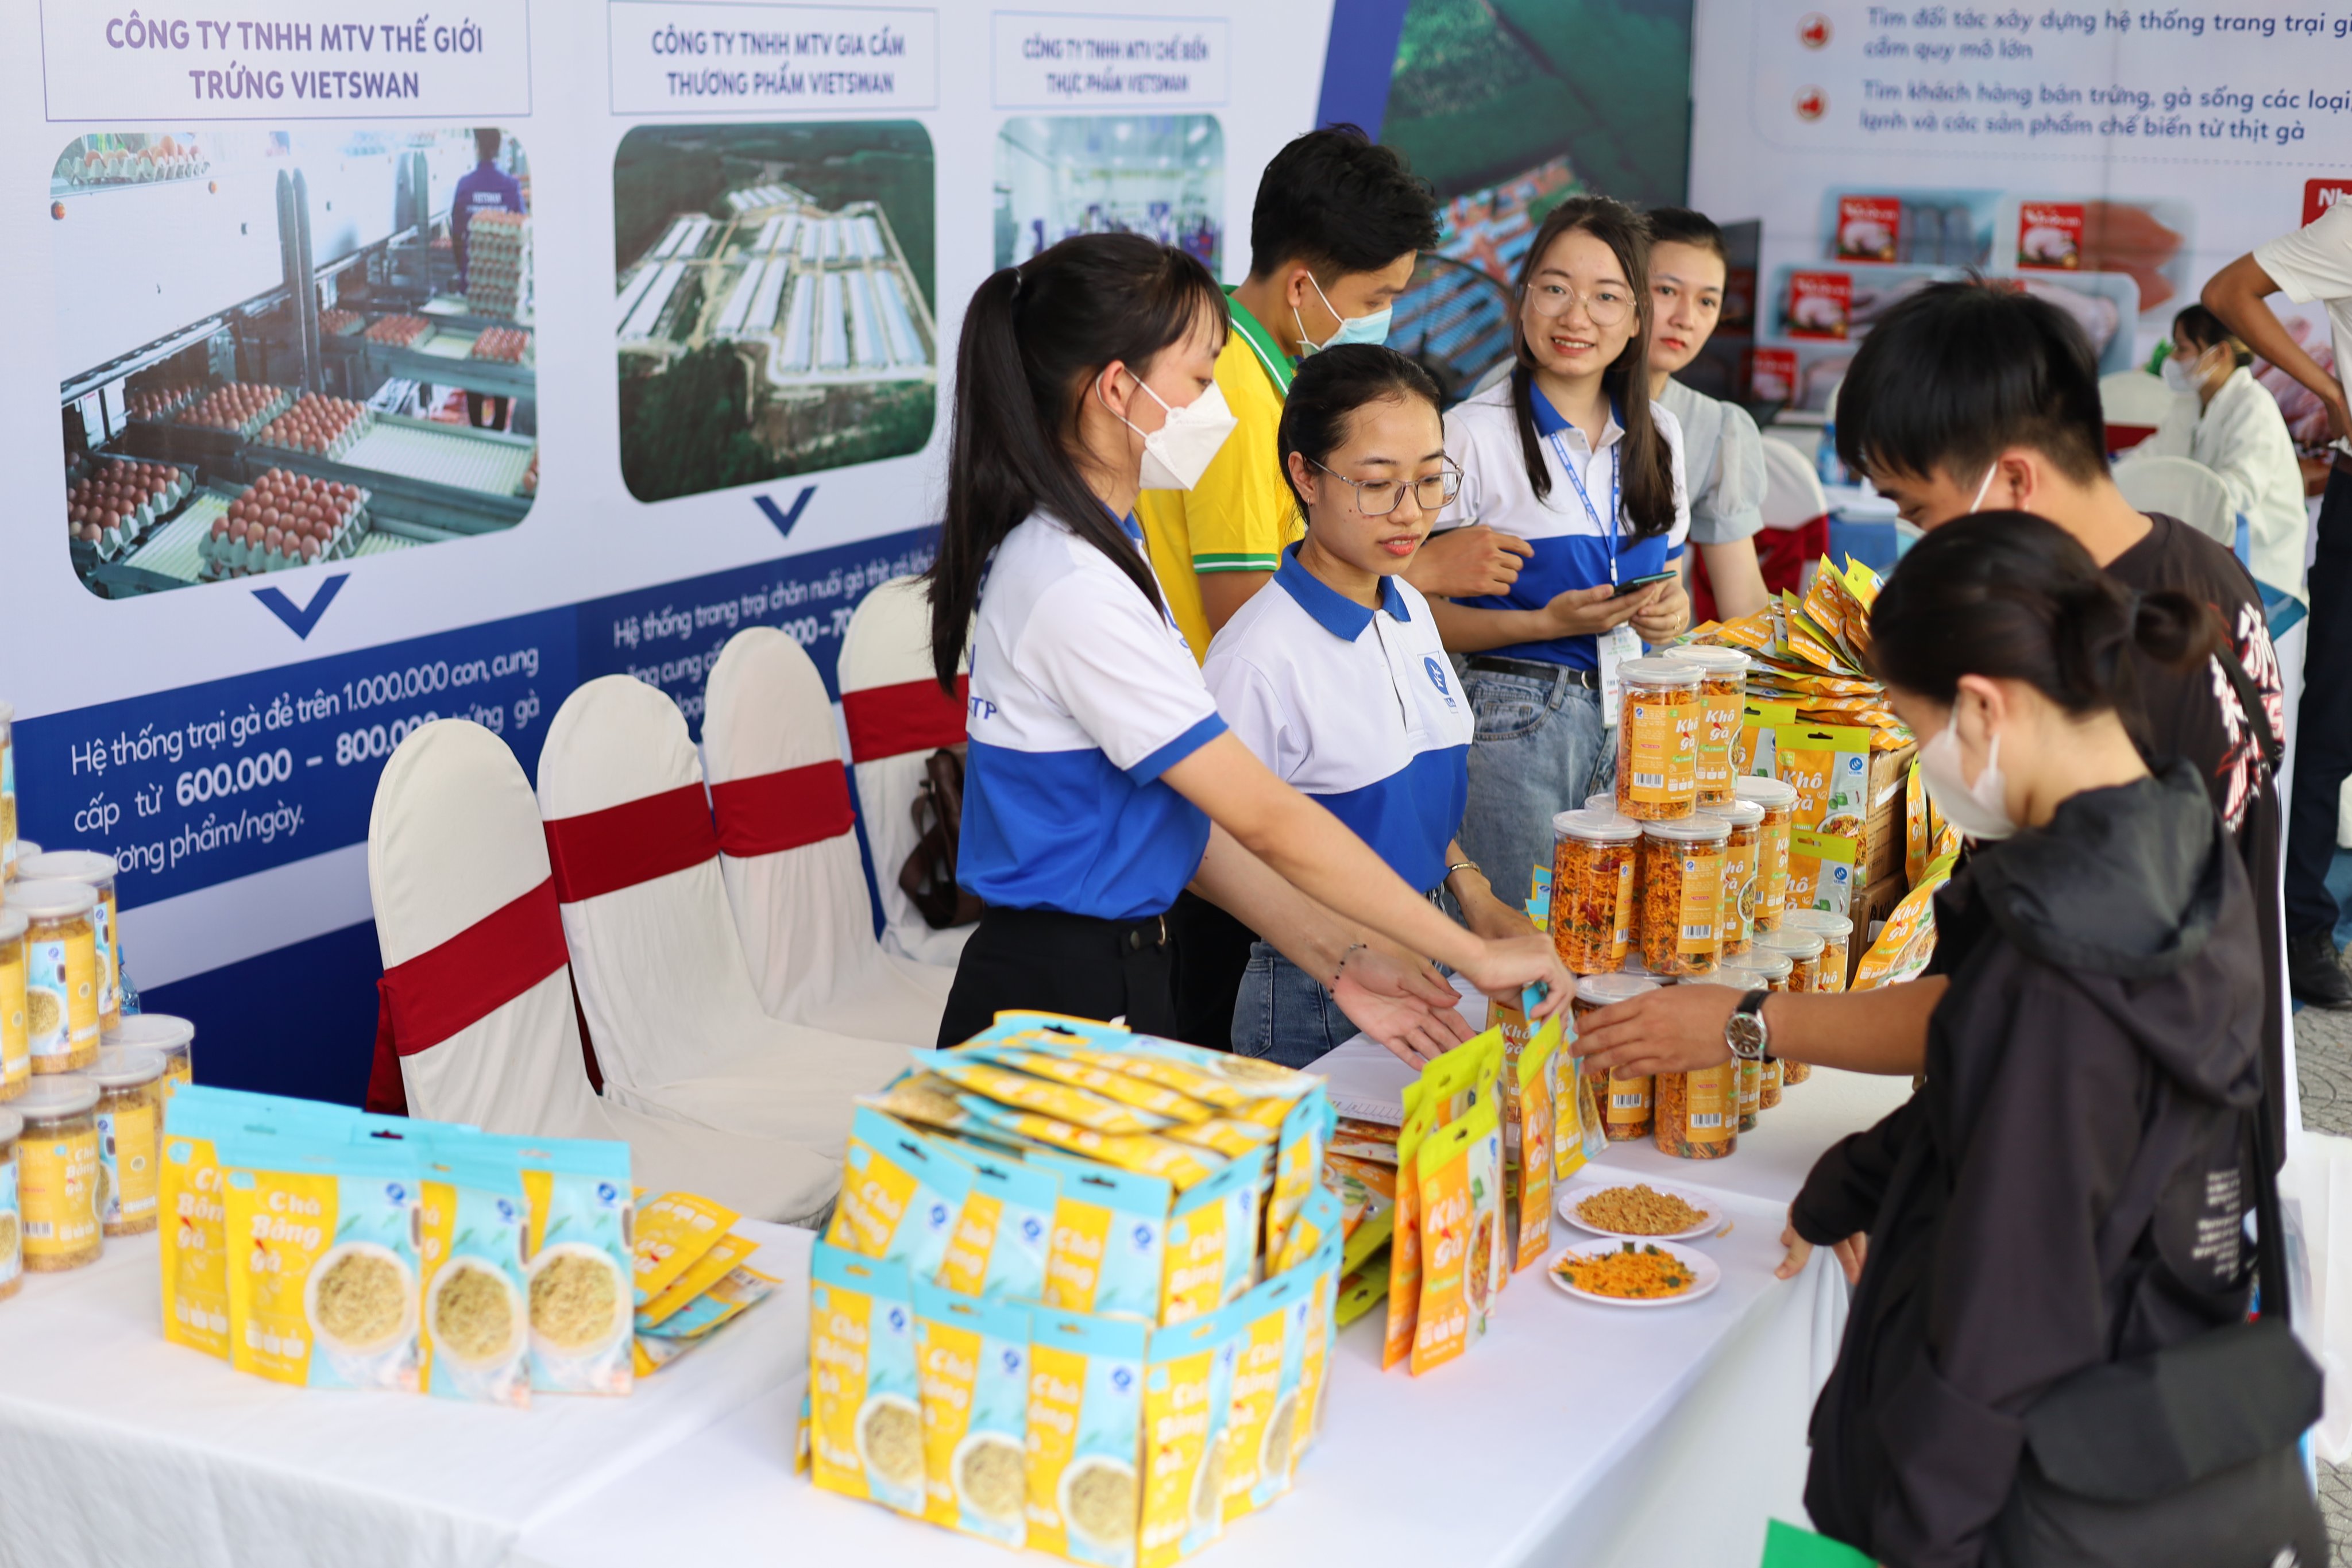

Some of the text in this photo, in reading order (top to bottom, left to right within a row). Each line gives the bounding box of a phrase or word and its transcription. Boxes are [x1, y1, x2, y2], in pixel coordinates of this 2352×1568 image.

[106, 9, 482, 53] CÔNG TY TNHH MTV THẾ GIỚI
[1867, 6, 1906, 28] Tìm
[1913, 5, 1946, 29] đối
[1954, 8, 1987, 29] tác
[1995, 9, 2033, 33] xây
[2040, 8, 2096, 35] dựng
[2104, 10, 2130, 32] hệ
[2139, 9, 2204, 36] thống
[2214, 14, 2276, 37] trang
[2285, 13, 2325, 36] trại
[652, 24, 706, 55] CÔNG
[713, 33, 735, 56] TY
[740, 33, 790, 56] TNHH
[795, 33, 832, 56] MTV
[836, 34, 866, 57] GIA
[1863, 35, 2033, 64] cầm quy mô lớn
[189, 60, 419, 99] TRỨNG VIETSWAN
[667, 71, 748, 96] THƯƠNG
[809, 72, 894, 95] VIETSWAN
[1864, 79, 1902, 101] Tìm
[1907, 80, 1971, 102] khách
[1977, 80, 2033, 109] hàng
[2039, 82, 2082, 103] bán
[2090, 84, 2155, 111] trứng,
[2163, 87, 2192, 112] gà
[2200, 85, 2254, 113] sống
[2262, 88, 2300, 109] các
[1913, 109, 1938, 132] và
[1943, 110, 1980, 133] các
[1986, 110, 2024, 133] sản
[2029, 111, 2093, 138] phẩm
[2099, 114, 2140, 137] chế
[2144, 114, 2191, 137] biến
[2199, 118, 2224, 138] từ
[2230, 118, 2269, 143] thịt
[2276, 121, 2305, 146] gà
[613, 616, 640, 650] Hệ
[643, 604, 692, 640] thống
[695, 601, 739, 628] trang
[741, 584, 768, 619] trại
[810, 567, 843, 601] nuôi
[844, 563, 865, 600] gà
[661, 654, 702, 683] cung
[72, 646, 539, 776] Hệ thống trại gà đẻ trên 1.000.000 con, cung
[1705, 709, 1735, 723] Khô
[1709, 727, 1730, 741] gà
[74, 791, 120, 837] cấp
[134, 782, 164, 818] từ
[176, 747, 292, 808] 600.000
[514, 690, 540, 729] gà
[1782, 770, 1823, 789] Khô
[1908, 795, 1922, 818] Khô
[171, 799, 305, 870] phẩm/ngày.
[1785, 874, 1809, 893] hô
[1890, 901, 1921, 923] Khô
[1886, 922, 1909, 942] gà
[1818, 971, 1837, 984] hô
[196, 1167, 222, 1192] Ch
[176, 1192, 223, 1222] Bôn
[268, 1190, 322, 1216] Chà
[1427, 1187, 1467, 1235] Khô
[176, 1226, 206, 1249] gà
[251, 1213, 322, 1251] Bông
[250, 1250, 283, 1273] gà
[1432, 1229, 1463, 1269] gà
